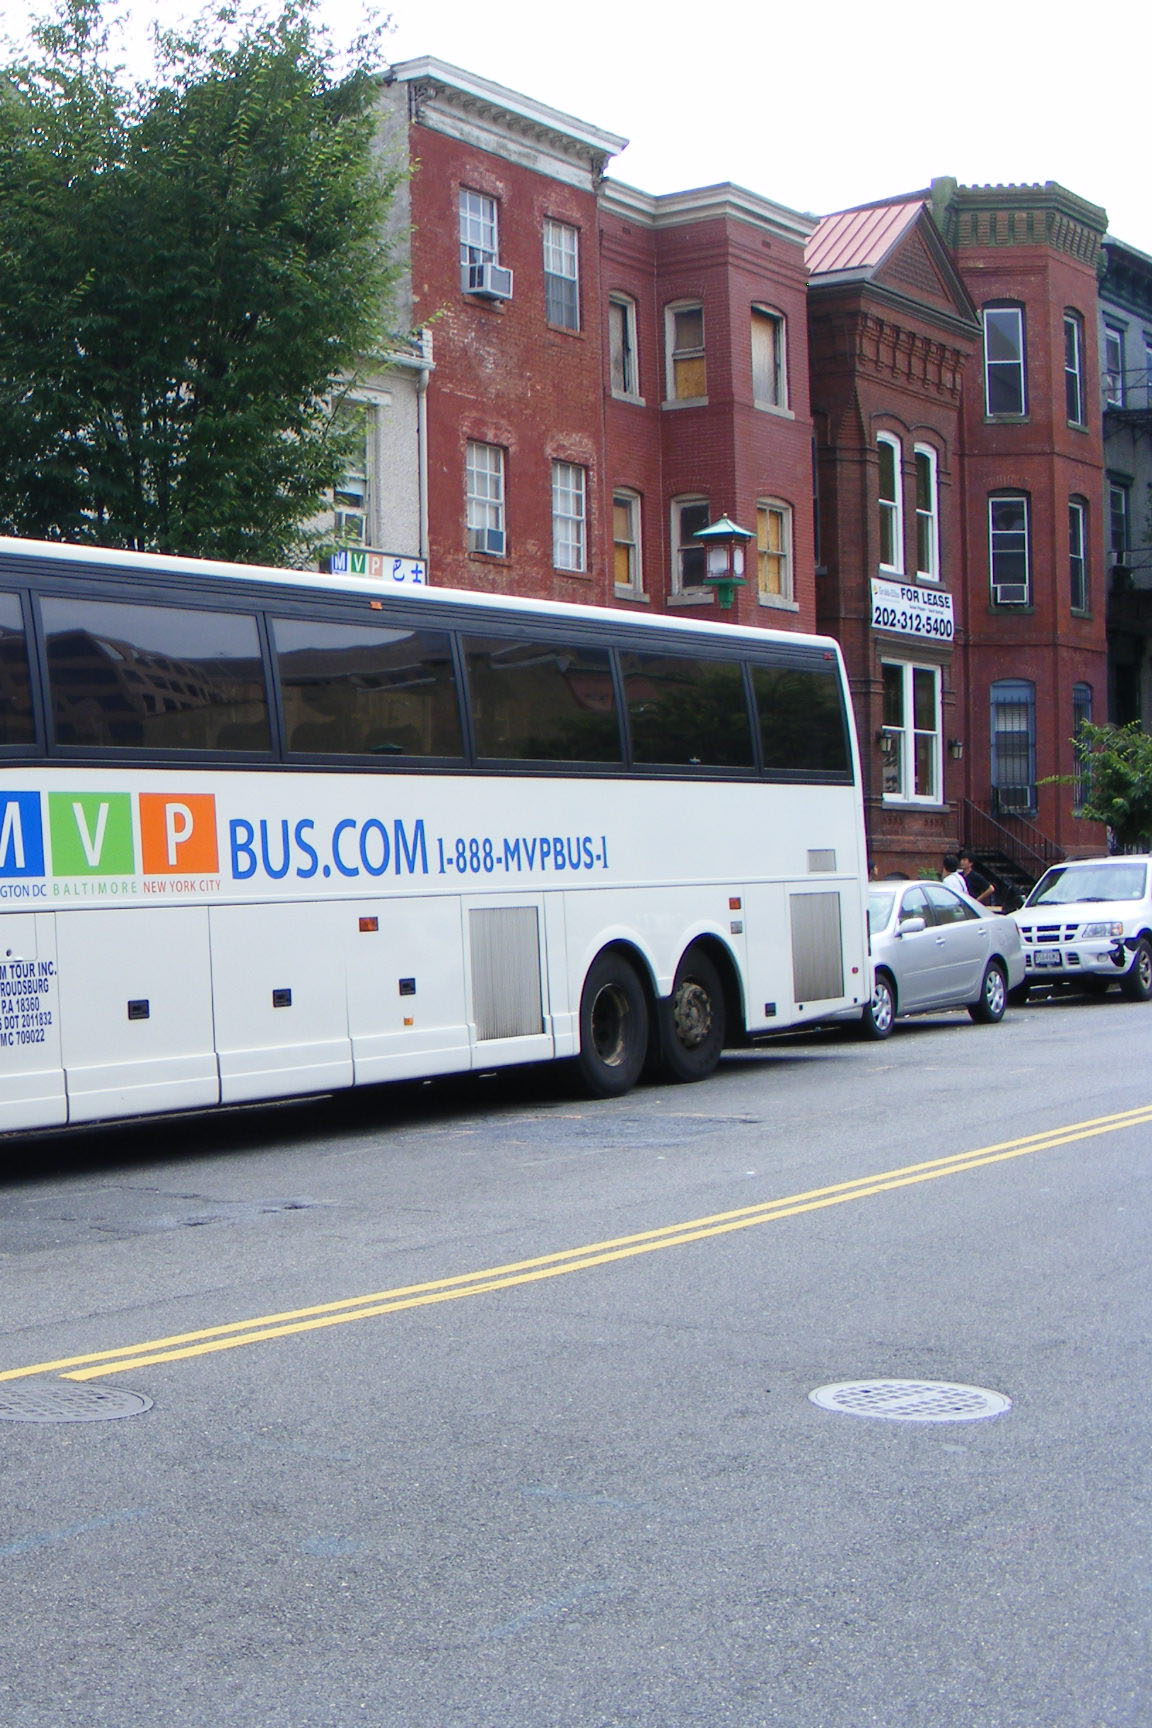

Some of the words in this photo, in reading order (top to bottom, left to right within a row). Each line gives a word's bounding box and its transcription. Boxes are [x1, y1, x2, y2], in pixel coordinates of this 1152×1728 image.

[901, 587, 919, 603] FOR
[922, 592, 950, 609] LEASE
[229, 818, 429, 880] BUS.COM
[436, 835, 609, 874] 1-888-MVPBUS-1
[31, 884, 47, 897] DC
[53, 881, 138, 896] BALTIMORE
[143, 880, 167, 894] NEW
[169, 880, 197, 893] YORK
[199, 879, 222, 892] CITY
[0, 965, 7, 980] M
[9, 963, 35, 979] TOUR
[38, 961, 57, 976] INC.
[16, 996, 40, 1013] 18360
[4, 1014, 19, 1030] DOT
[22, 1011, 52, 1028] 2011832
[0, 1032, 14, 1047] MC
[16, 1028, 45, 1045] 709022
